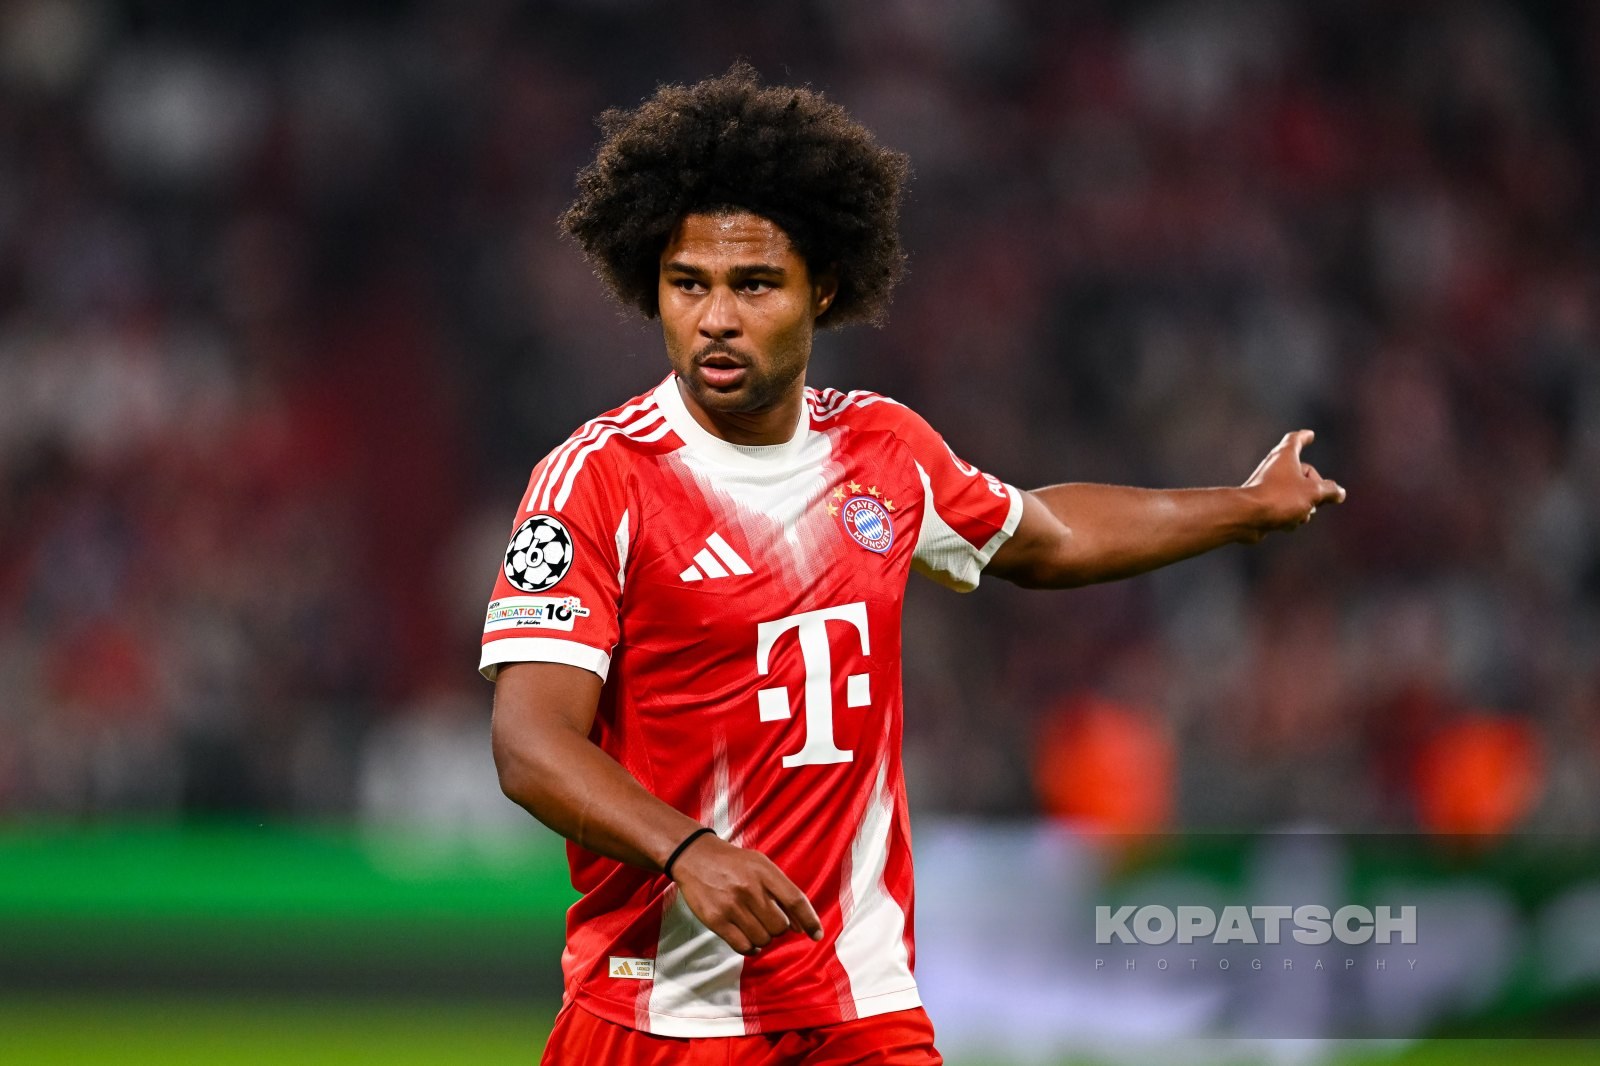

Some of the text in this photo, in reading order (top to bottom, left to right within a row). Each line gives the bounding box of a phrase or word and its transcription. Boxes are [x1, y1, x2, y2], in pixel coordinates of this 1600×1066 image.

[847, 501, 885, 523] FC BAYERN
[525, 538, 544, 568] 6
[545, 603, 572, 621] 10
[756, 601, 871, 768] T
